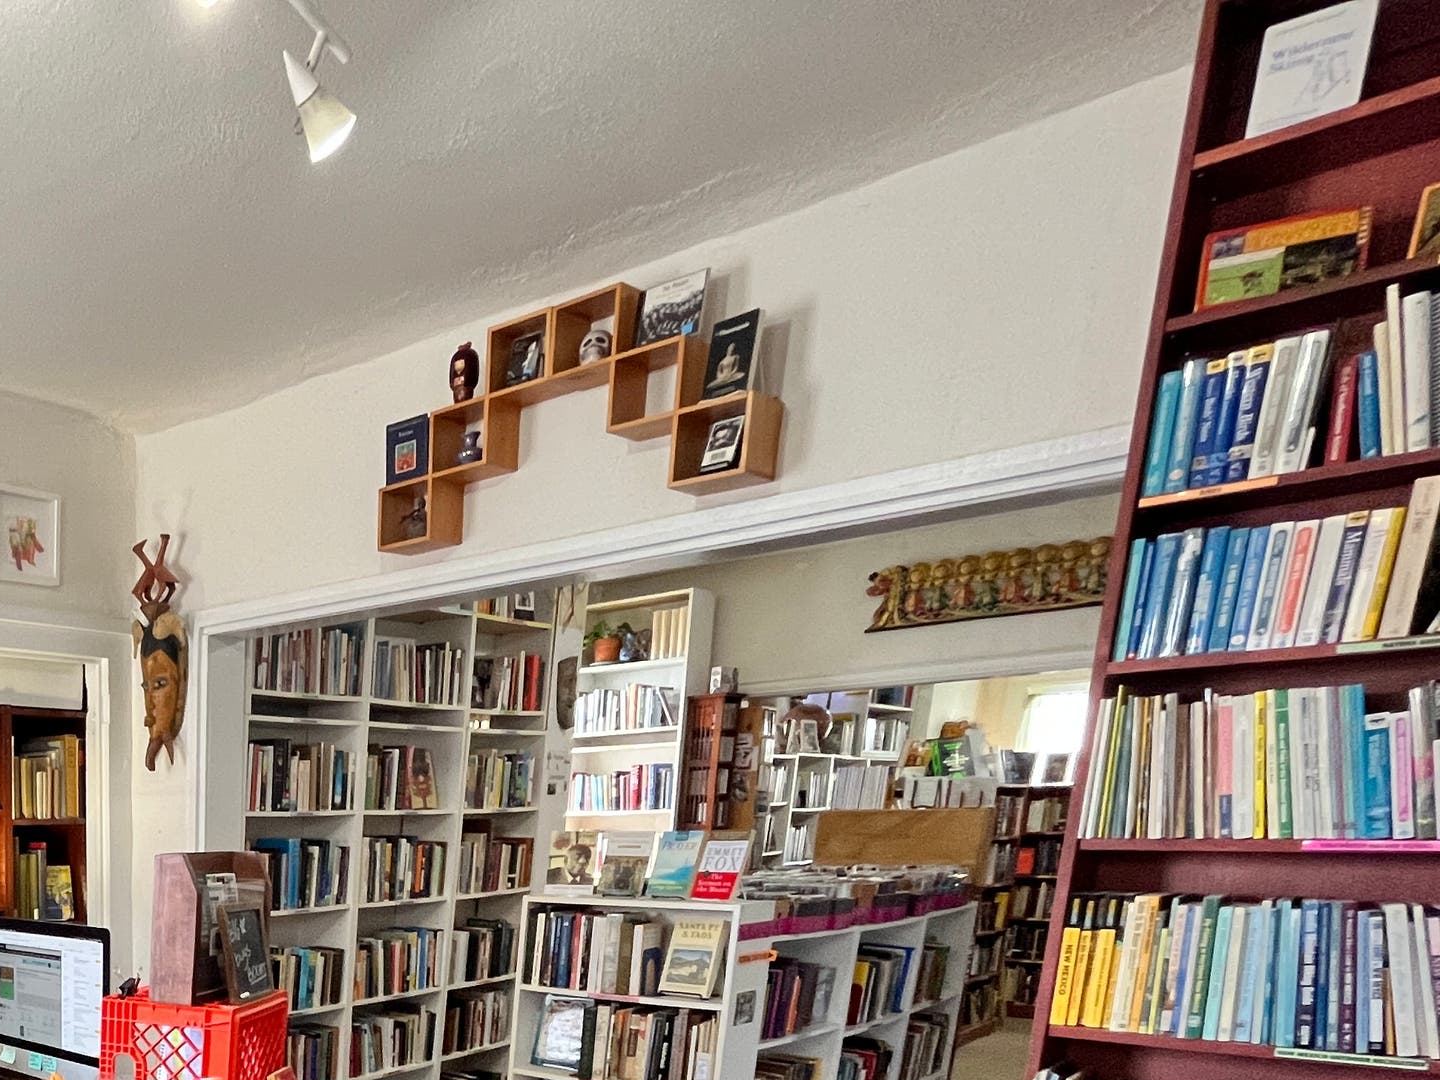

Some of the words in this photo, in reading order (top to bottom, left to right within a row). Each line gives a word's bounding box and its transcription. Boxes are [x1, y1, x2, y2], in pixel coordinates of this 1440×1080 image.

[1335, 531, 1363, 586] Mammals
[707, 847, 745, 856] EMMET
[704, 856, 740, 871] FOX
[1064, 944, 1073, 963] NEW
[1058, 964, 1070, 995] MEXICO
